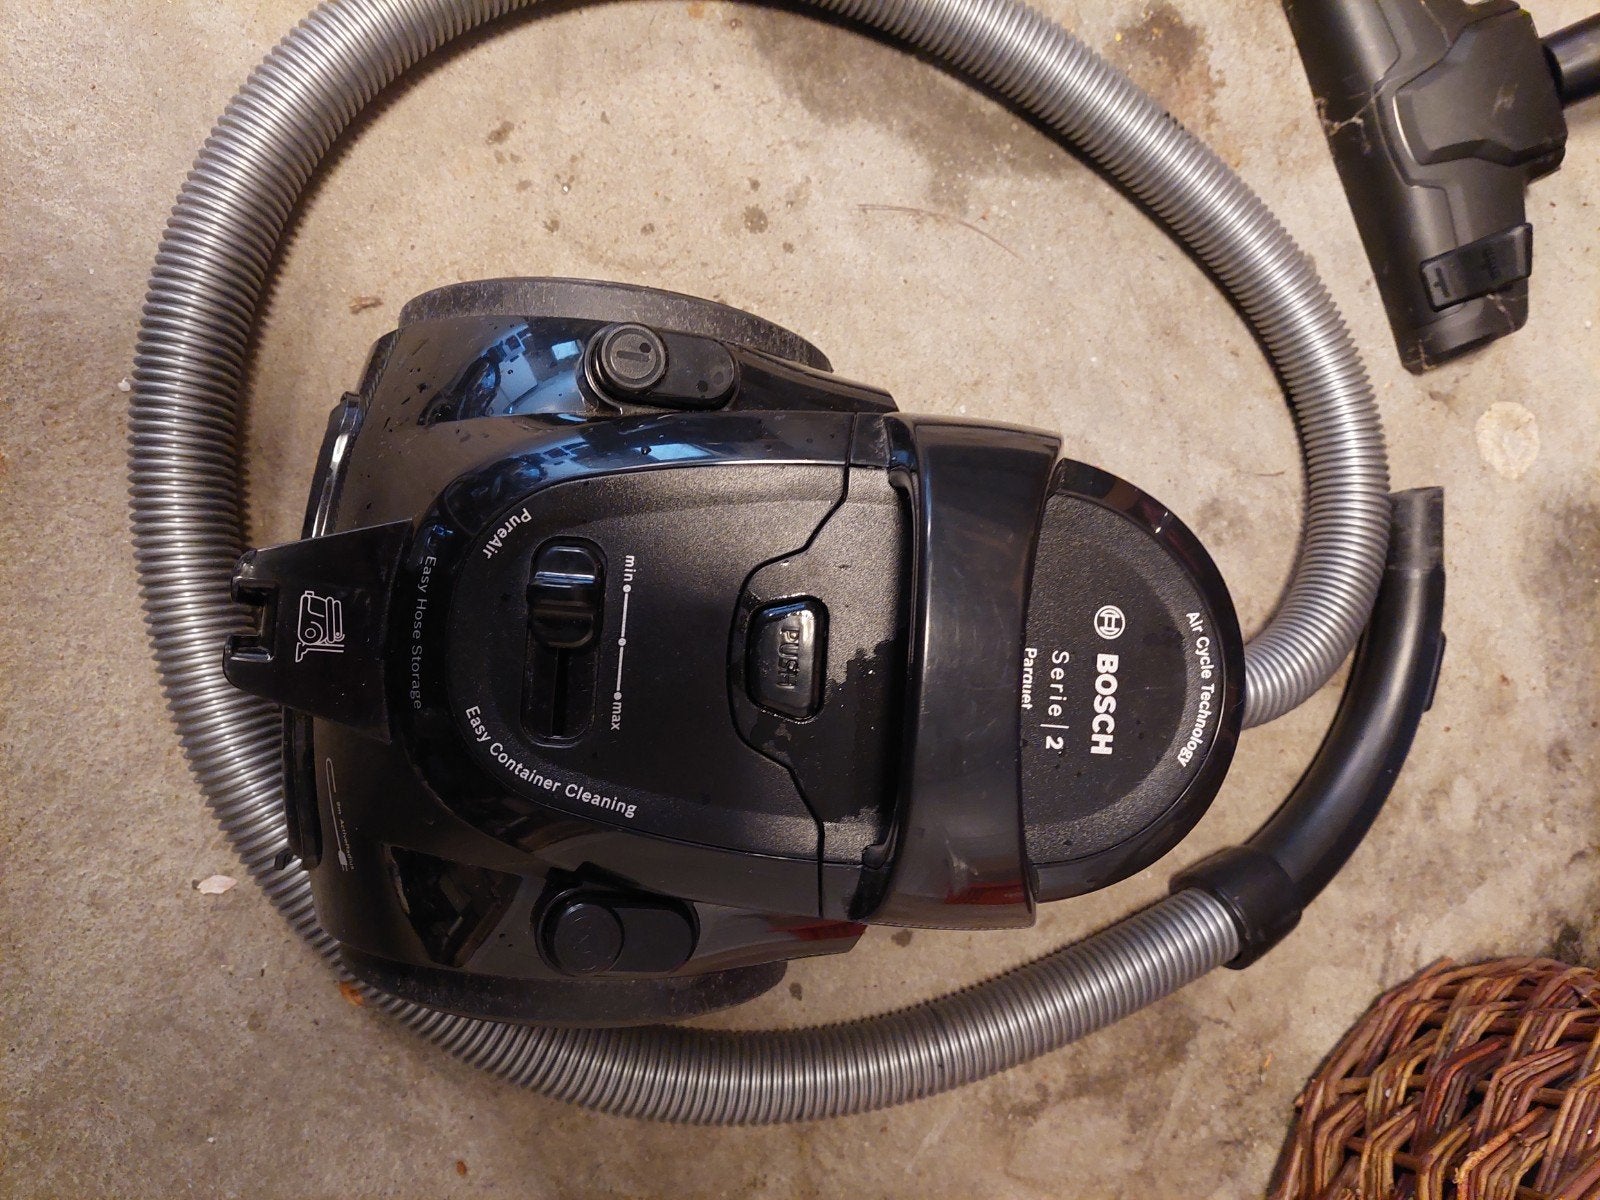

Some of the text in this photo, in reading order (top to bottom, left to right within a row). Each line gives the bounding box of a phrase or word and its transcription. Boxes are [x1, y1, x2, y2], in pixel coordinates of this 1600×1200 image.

[483, 507, 532, 560] PureAir
[624, 554, 637, 583] min
[409, 555, 438, 710] Easy Hose Storage
[776, 628, 801, 690] PUSH
[610, 701, 623, 732] max
[1090, 653, 1119, 755] BOSCH
[1177, 612, 1215, 767] Air Cycle Technology
[465, 706, 638, 819] Easy Container Cleaning
